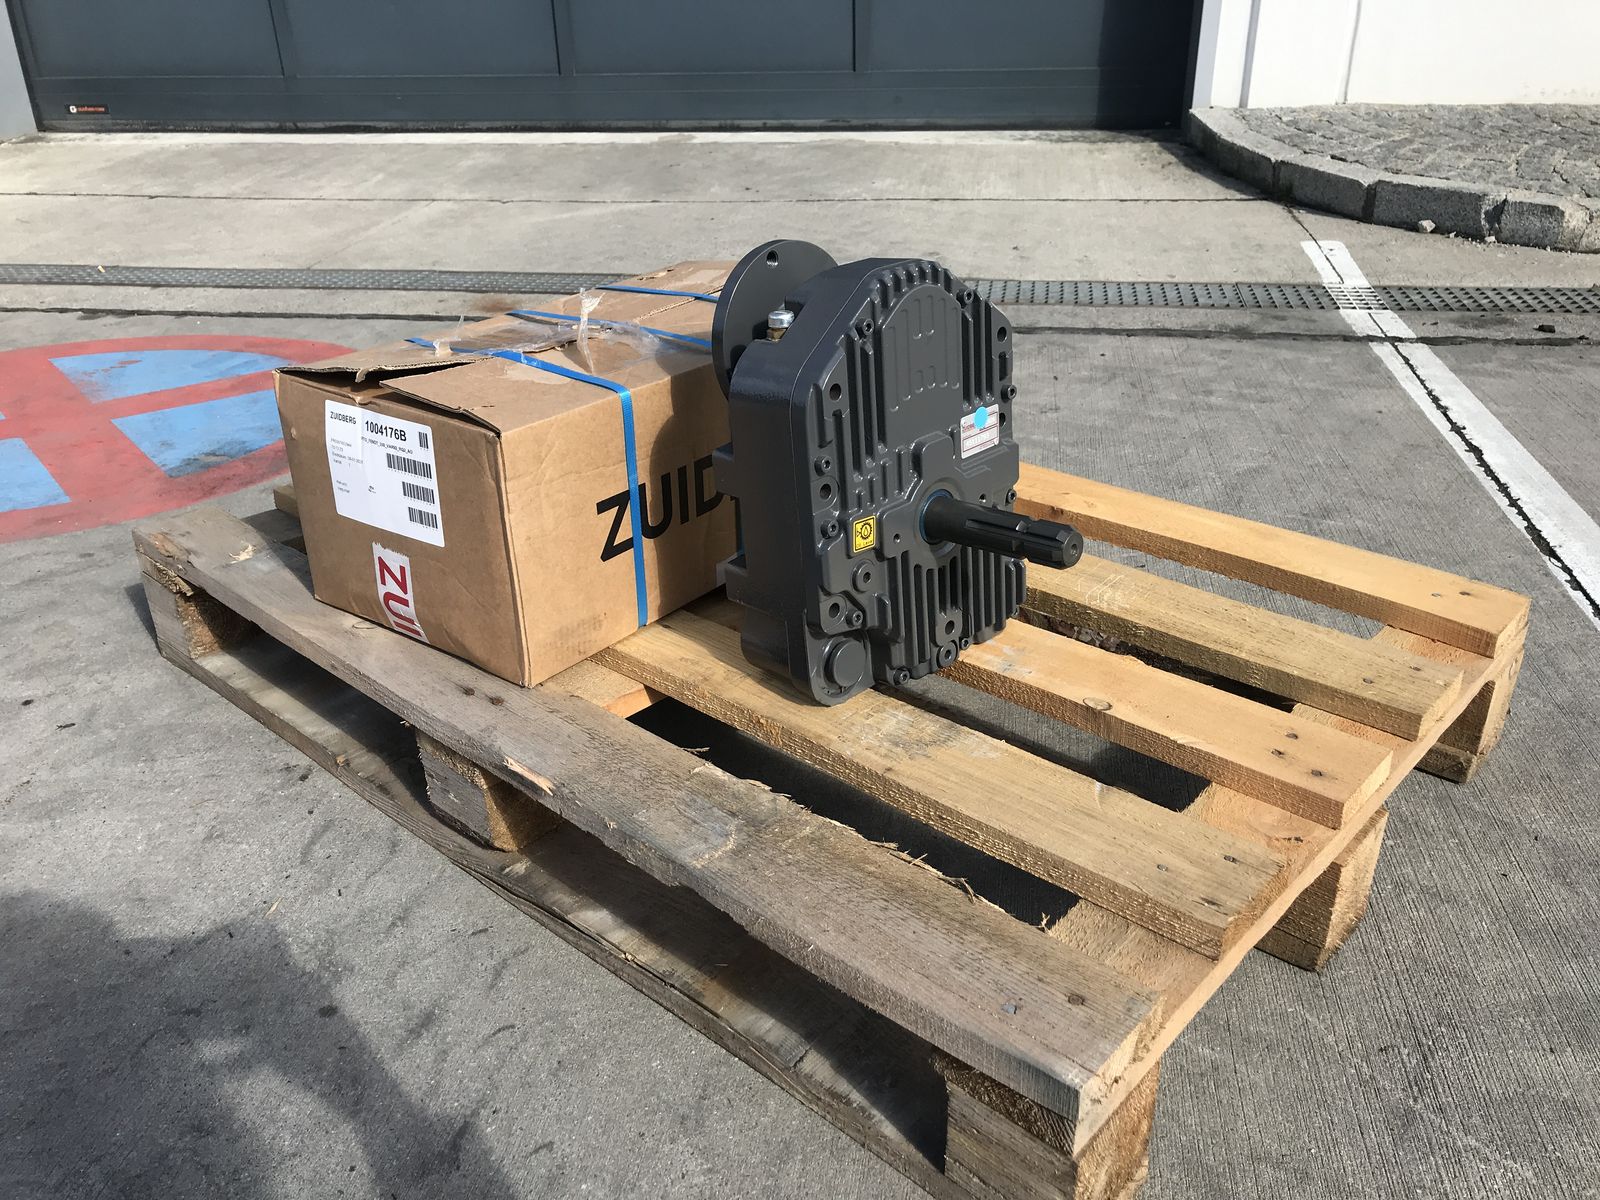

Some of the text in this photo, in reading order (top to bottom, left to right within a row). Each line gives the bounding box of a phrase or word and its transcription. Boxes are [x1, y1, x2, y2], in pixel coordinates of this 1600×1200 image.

[330, 411, 357, 425] ZUIDBERG
[365, 420, 407, 442] 1004176B
[596, 454, 738, 562] ZUID
[378, 556, 422, 637] ZUI
